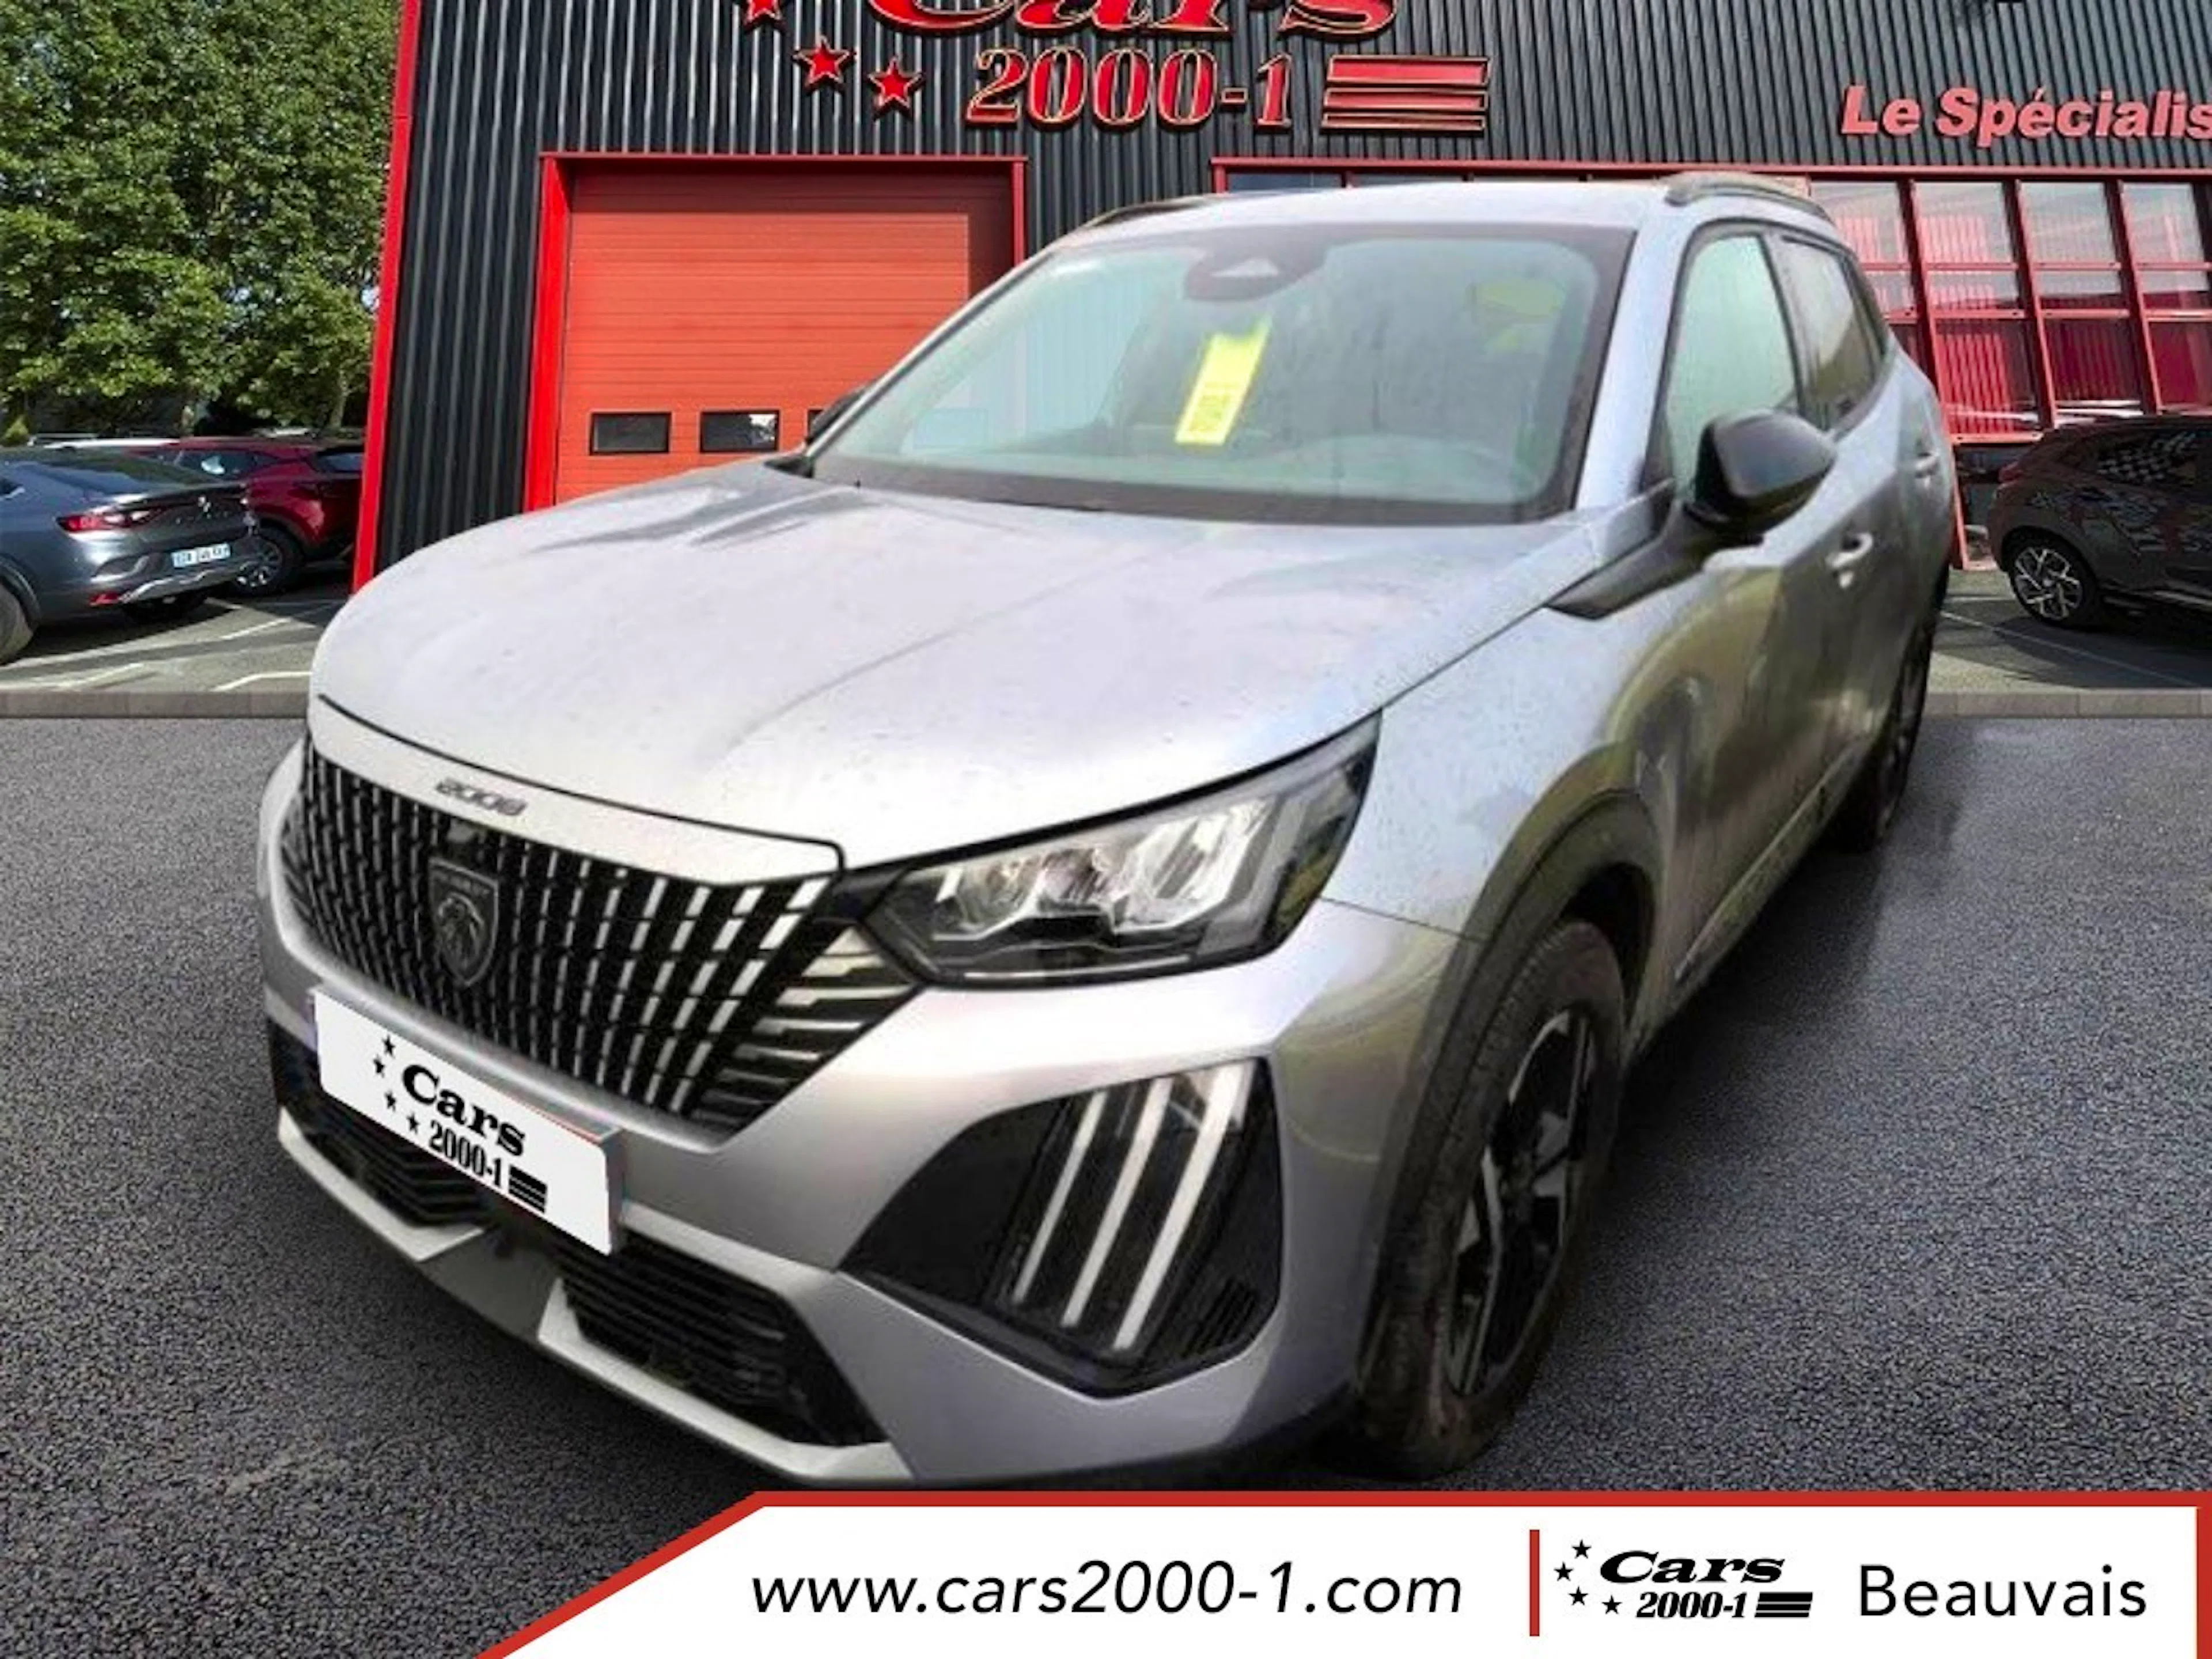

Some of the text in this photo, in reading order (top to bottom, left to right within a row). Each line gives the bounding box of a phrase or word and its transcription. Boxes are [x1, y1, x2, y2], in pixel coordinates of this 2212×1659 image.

[964, 47, 1293, 128] 2000-1
[1842, 85, 1921, 135] Le
[402, 1064, 525, 1156] Cars
[428, 1119, 502, 1188] 2000-1
